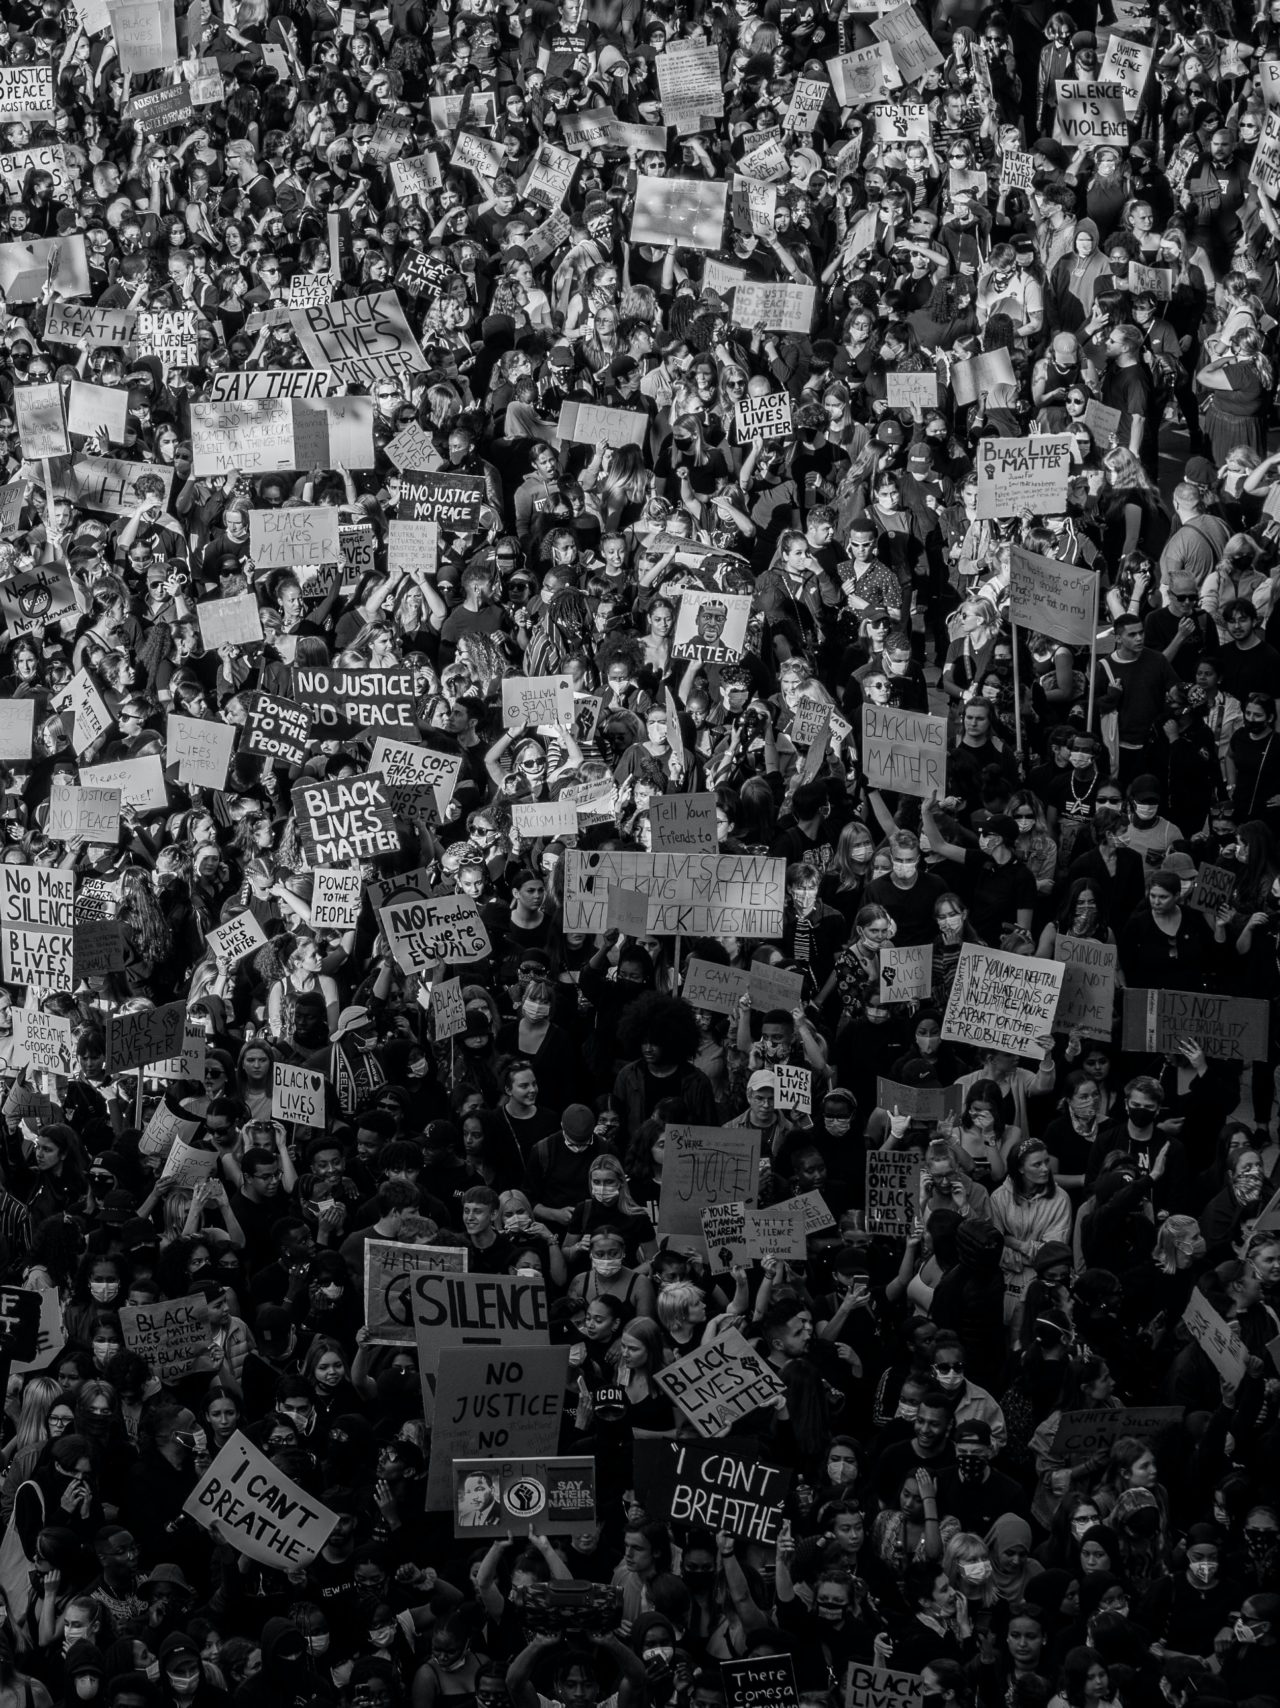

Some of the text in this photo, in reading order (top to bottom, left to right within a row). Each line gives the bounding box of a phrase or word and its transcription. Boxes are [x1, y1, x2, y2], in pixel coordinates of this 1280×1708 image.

[10, 69, 52, 84] JUSTICE
[8, 84, 46, 98] PEACE
[1061, 85, 1120, 99] SILENCE
[25, 99, 52, 111] POLICE
[876, 105, 925, 117] JUSTICE
[1083, 103, 1099, 114] IS
[1062, 119, 1127, 137] VIOLENCE
[306, 294, 389, 332] BLACK
[320, 322, 401, 361] LIVES
[330, 351, 414, 386] MATTER
[214, 373, 327, 399] SAY THEIR
[740, 395, 787, 412] BLACK
[743, 410, 782, 425] LIVES
[738, 422, 791, 442] MATTER
[984, 441, 1069, 461] BLACK LIVES
[1001, 456, 1061, 471] MATTER
[400, 482, 479, 504] #NO JUSTICE
[415, 504, 471, 521] NO PEACE
[298, 673, 412, 697] NO JUSTICE
[258, 698, 307, 728] POWER
[346, 704, 414, 725] PEACE
[250, 714, 308, 740] TO THE
[865, 709, 943, 746] BLACK LIVES
[250, 732, 304, 764] PEOPLE
[870, 751, 939, 786] MATTER
[304, 782, 386, 815] BLACK
[310, 808, 382, 839] LIVES
[317, 832, 399, 859] MATTER
[319, 877, 358, 890] POWER
[324, 894, 349, 902] TO THE
[8, 899, 73, 928] SILENCE
[316, 908, 355, 923] PEOPLE
[392, 904, 479, 932] NO Freedom
[11, 936, 71, 955] BLACK
[409, 944, 478, 965] EQUAL
[11, 953, 67, 971] LIVES
[10, 969, 71, 990] MATTER
[777, 1068, 809, 1081] BLACK
[780, 1079, 808, 1090] LIVES
[780, 1089, 811, 1105] MATTER
[870, 1152, 919, 1163] ALL LIVES
[869, 1175, 906, 1188] ONCE
[871, 1190, 914, 1208] BLACK
[871, 1208, 896, 1220] LIVES
[417, 1274, 550, 1331] SILENCE
[487, 1362, 523, 1384] NO
[663, 1342, 738, 1396] BLACK
[597, 1389, 622, 1401] ICON
[678, 1367, 744, 1412] LIVES
[453, 1394, 558, 1423] JUSTICE
[698, 1373, 785, 1435] MATTER
[479, 1429, 509, 1449] NO
[551, 1490, 591, 1498] THEIR
[557, 1481, 583, 1491] SAY
[247, 1475, 319, 1528] CANT
[548, 1499, 594, 1509] NAMES
[852, 1668, 922, 1698] BLACK
